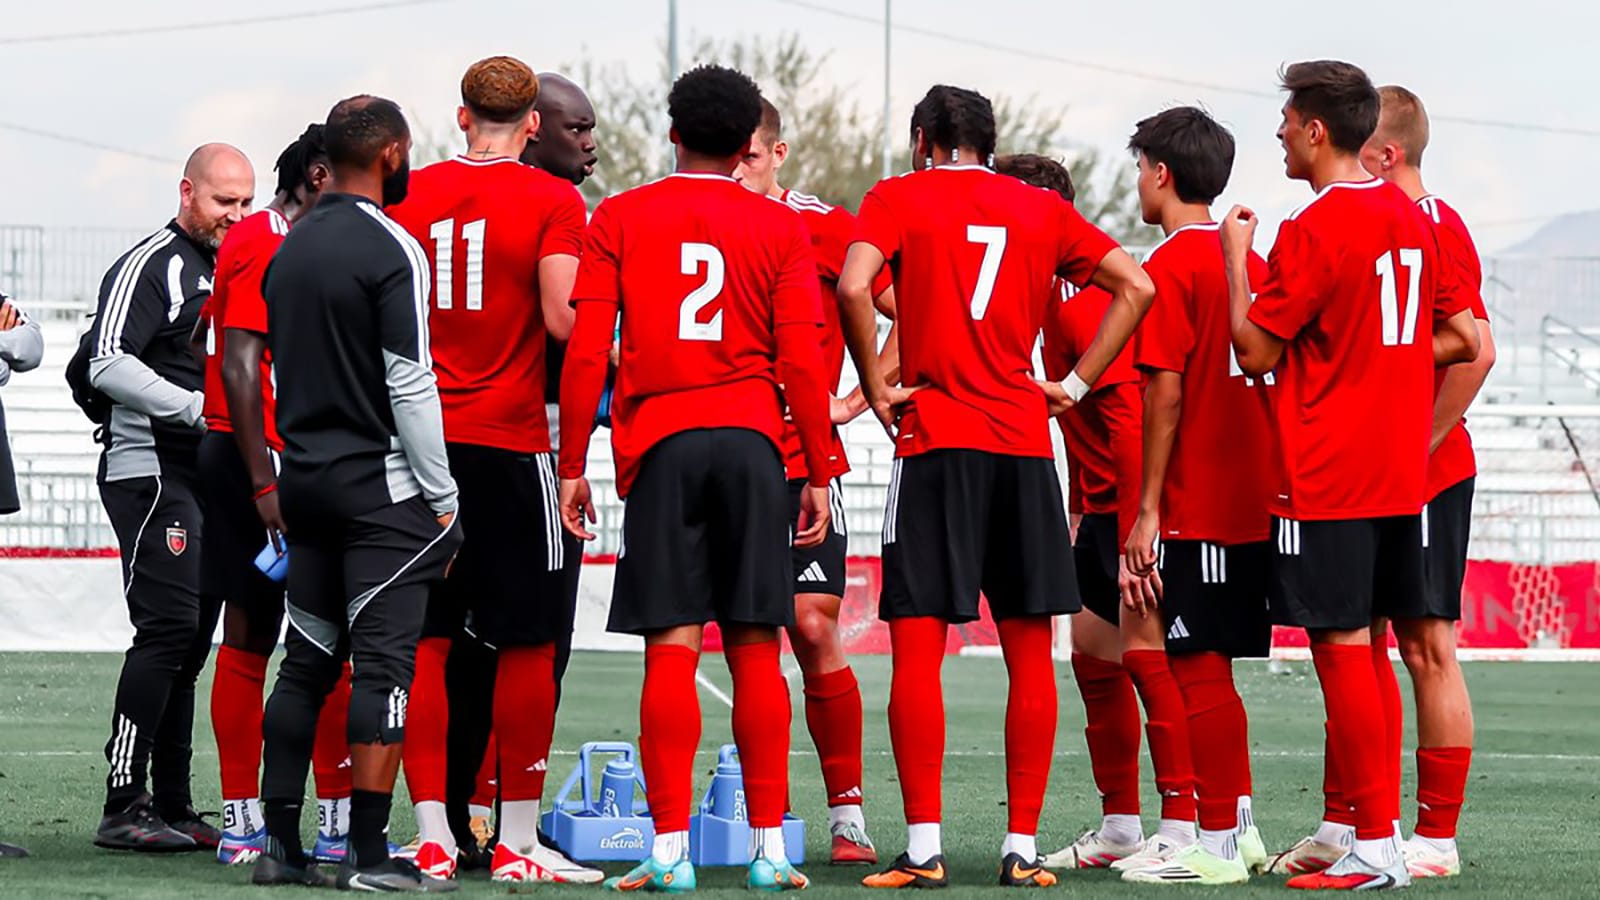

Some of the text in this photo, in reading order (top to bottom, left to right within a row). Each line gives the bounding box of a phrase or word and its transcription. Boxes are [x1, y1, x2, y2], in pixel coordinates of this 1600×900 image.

[430, 218, 486, 311] 11
[678, 242, 725, 341] 2
[967, 225, 1007, 321] 7
[1375, 248, 1423, 346] 17
[600, 838, 644, 849] Electrolit
